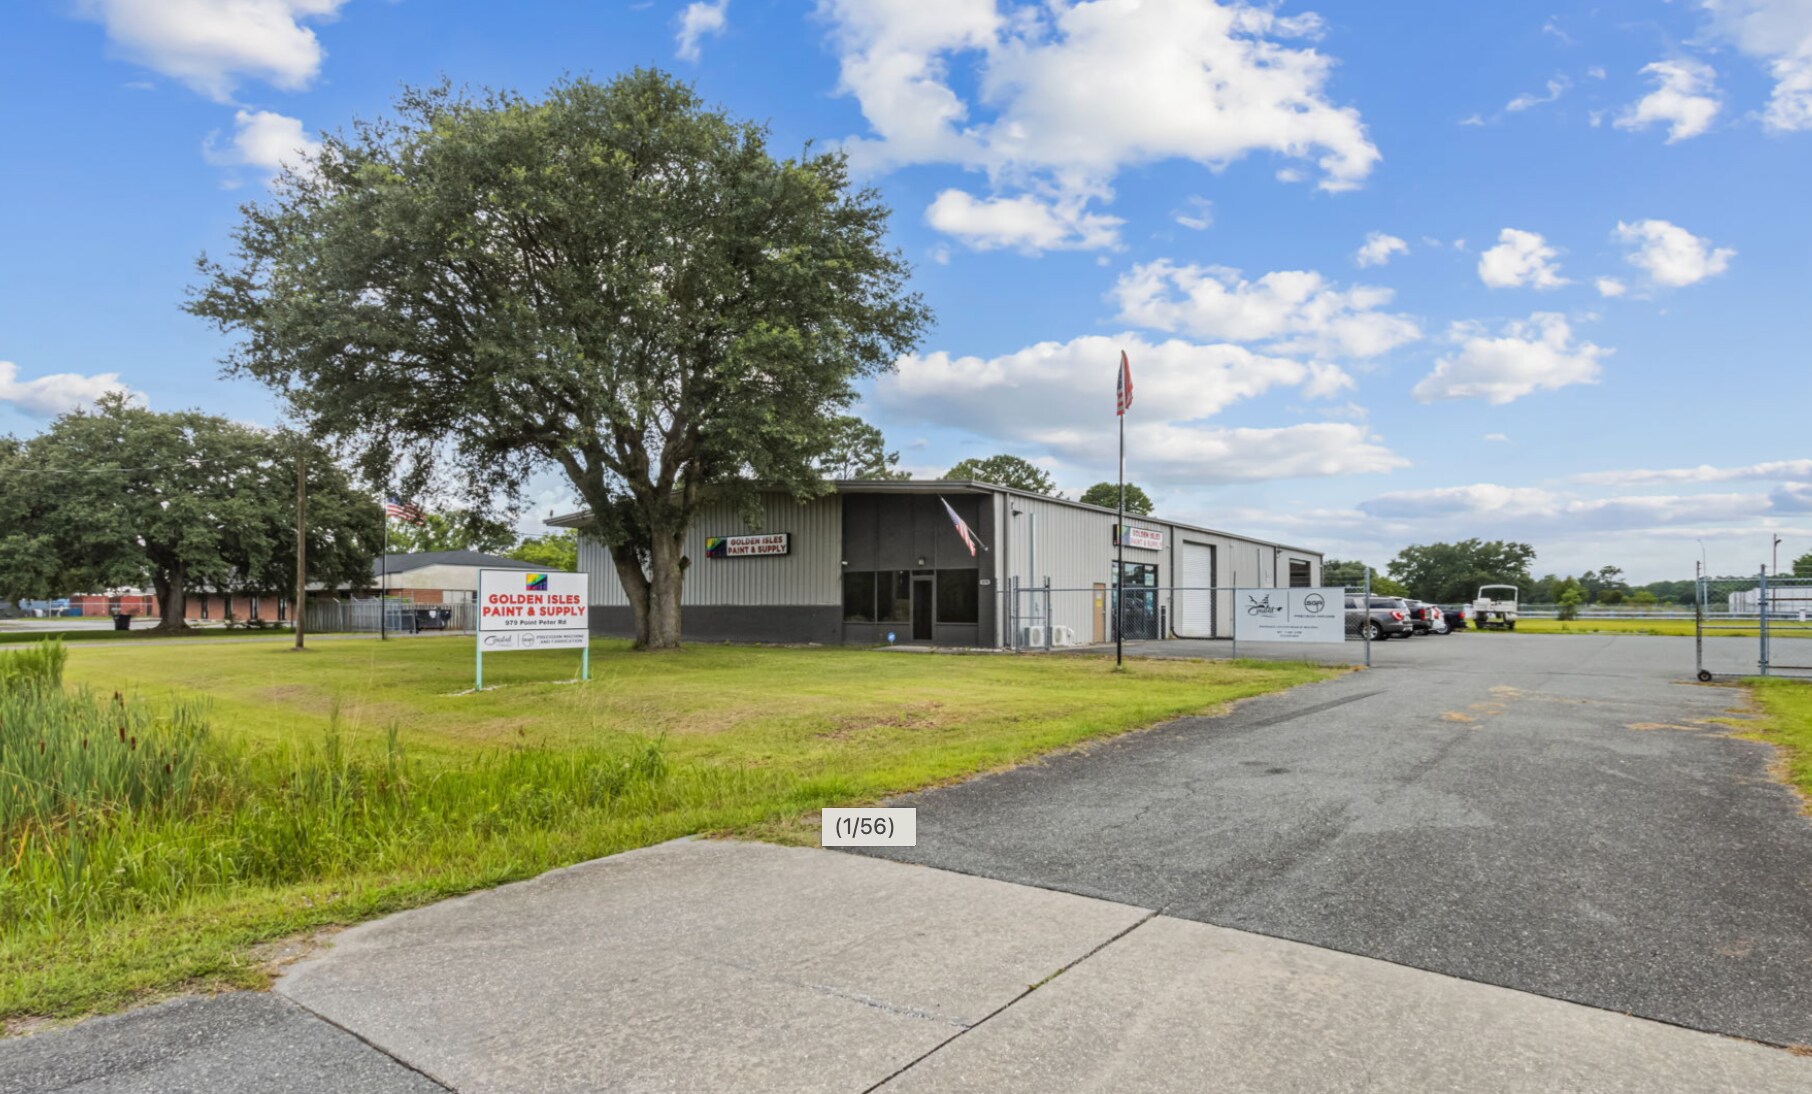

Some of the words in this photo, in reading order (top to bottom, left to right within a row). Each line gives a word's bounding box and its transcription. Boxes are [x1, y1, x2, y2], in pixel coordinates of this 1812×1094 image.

[730, 538, 760, 546] GOLDEN
[762, 535, 783, 544] ISLES
[728, 546, 749, 554] PAINT
[758, 545, 786, 553] SUPPLY
[488, 593, 543, 605] GOLDEN
[547, 594, 581, 604] ISLES
[483, 606, 524, 617] PAINT
[527, 606, 535, 616] &
[539, 606, 586, 616] SUPPLY
